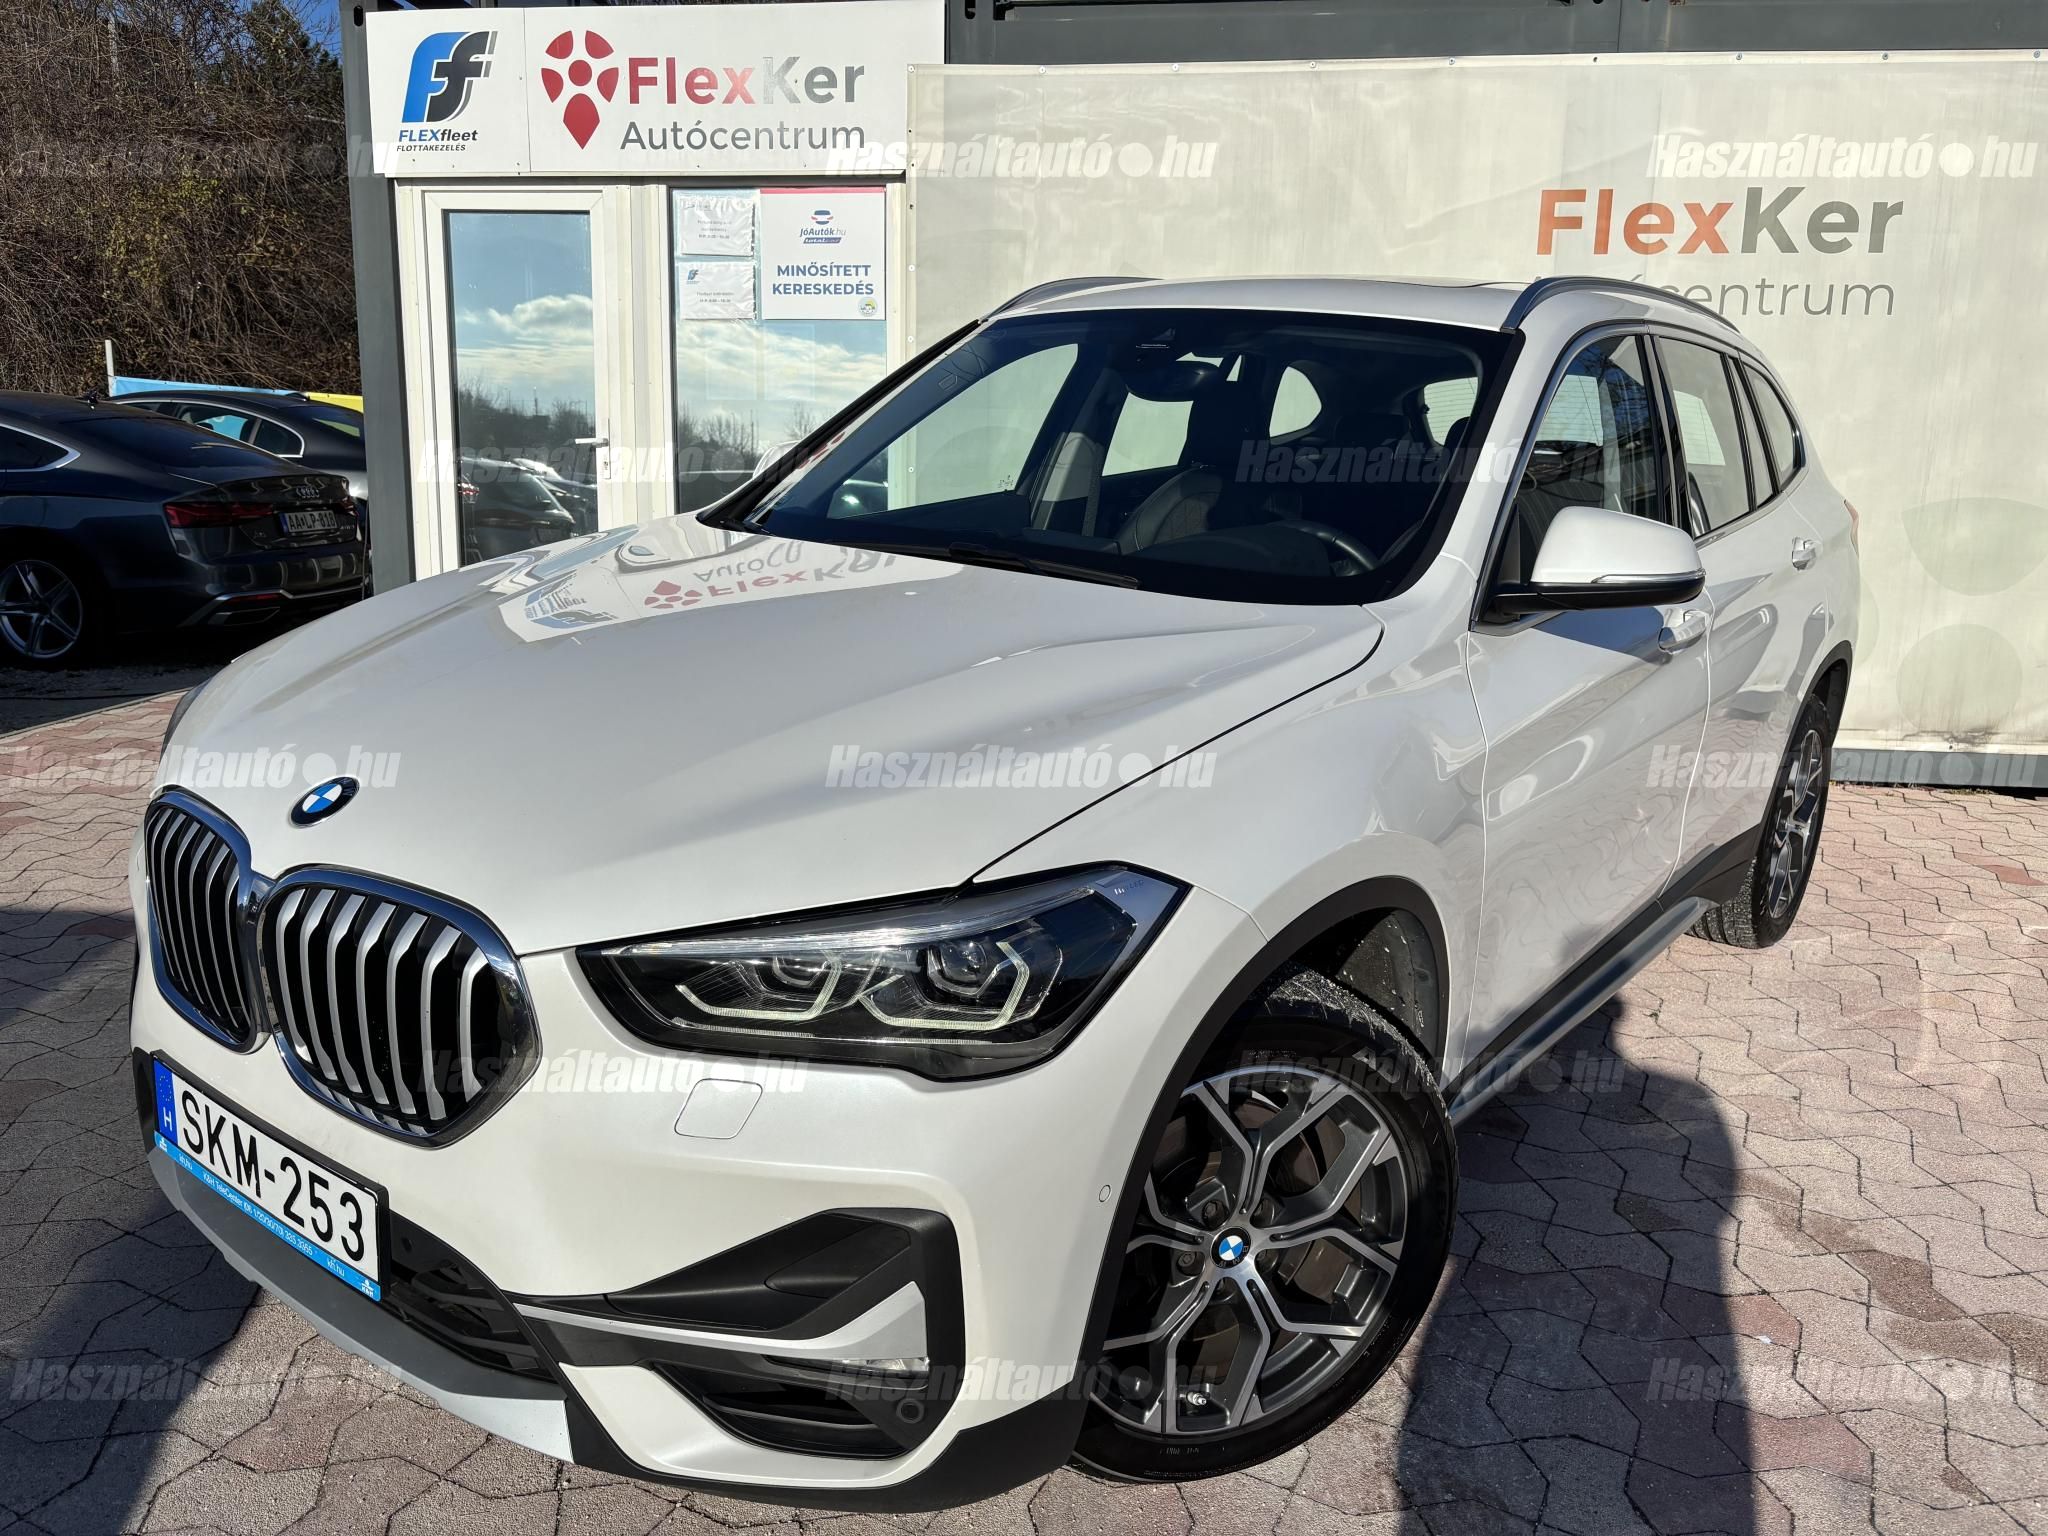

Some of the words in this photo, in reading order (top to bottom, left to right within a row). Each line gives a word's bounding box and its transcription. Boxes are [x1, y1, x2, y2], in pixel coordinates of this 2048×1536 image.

[628, 56, 864, 105] FlexKer
[398, 129, 478, 142] FLEXfleet
[620, 120, 865, 150] Autócentrum
[1536, 186, 1904, 255] FlexKer
[772, 280, 874, 295] KERESKEDÉS
[163, 1106, 173, 1132] H
[182, 1090, 365, 1262] SKM-253
